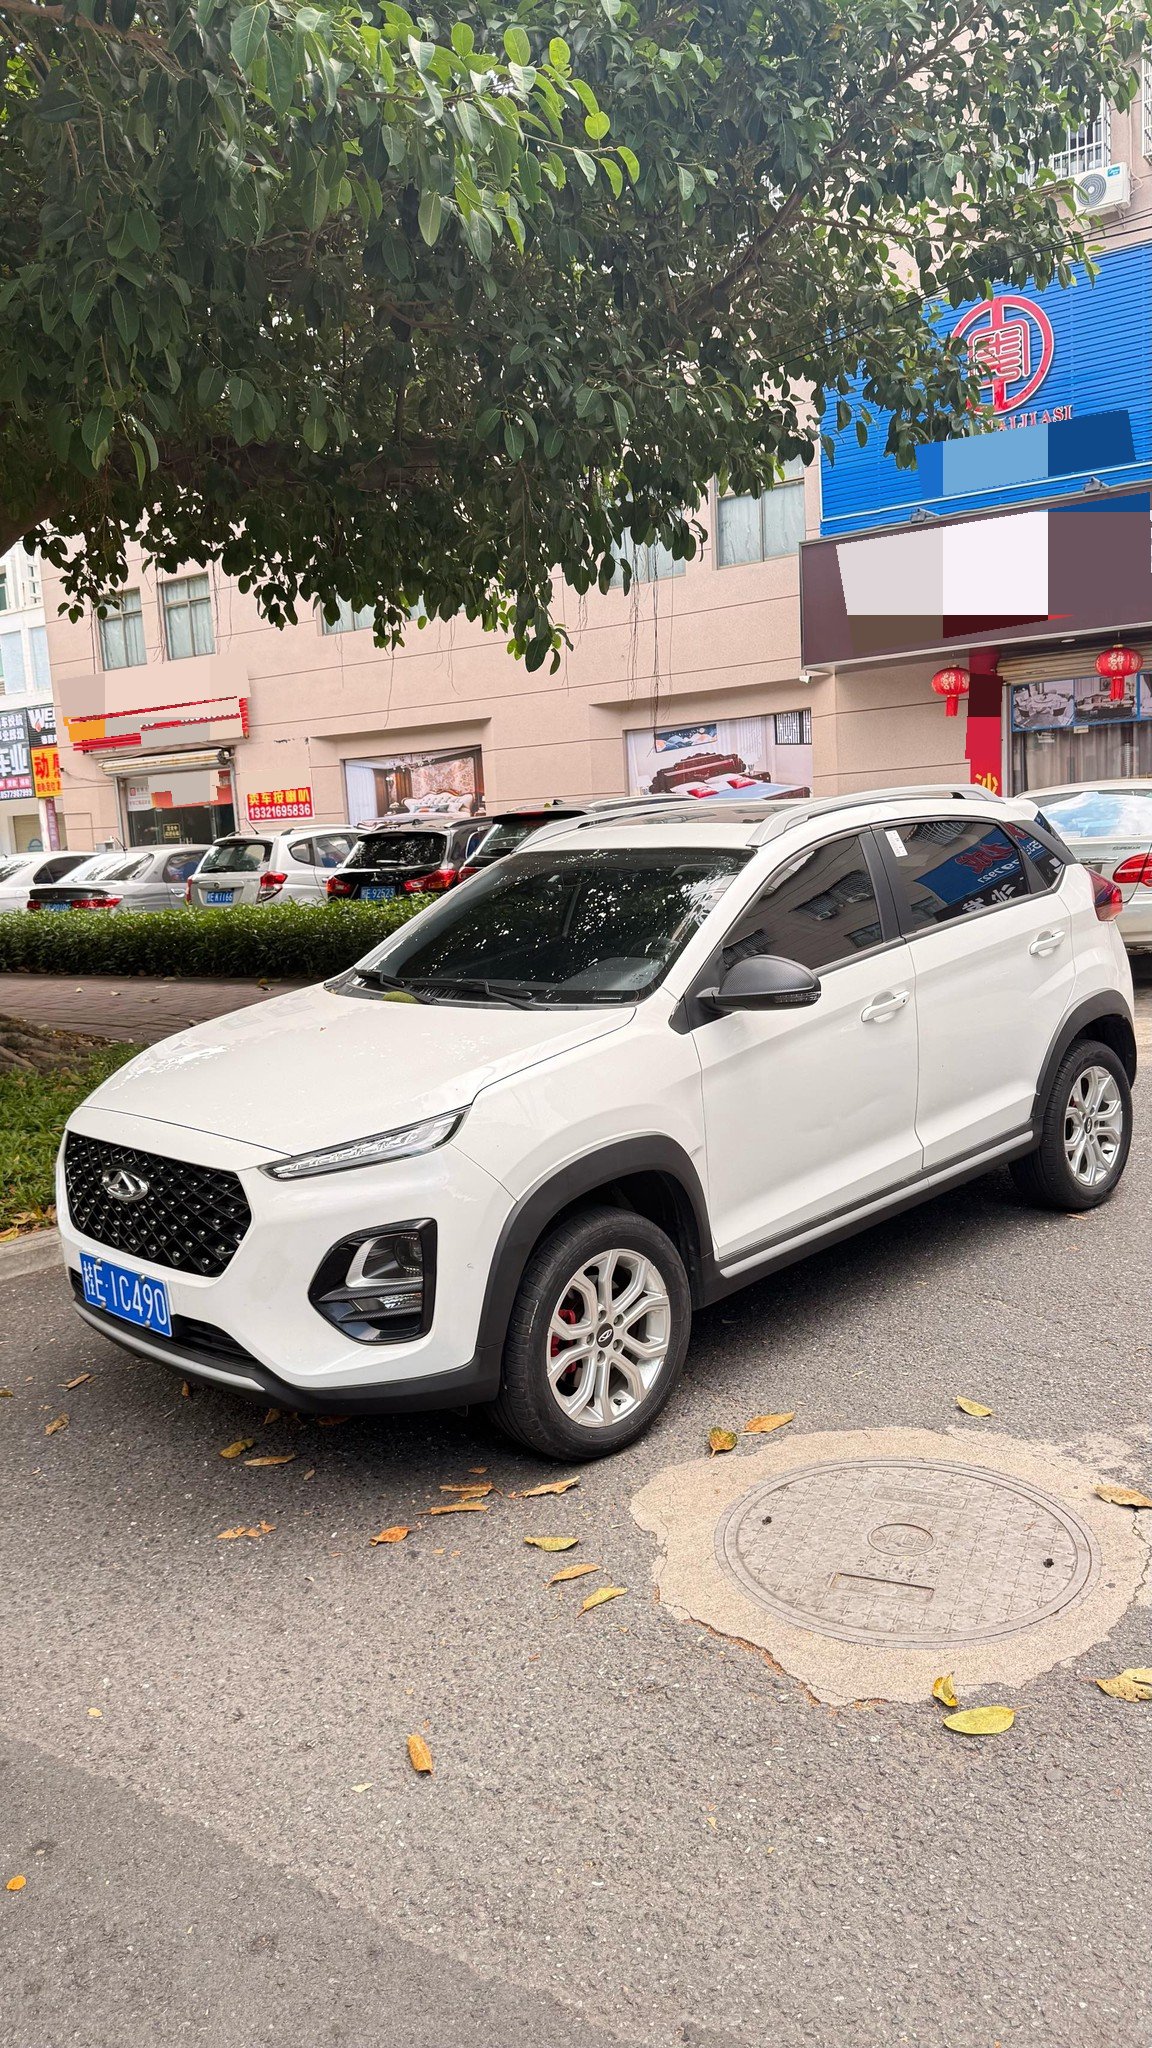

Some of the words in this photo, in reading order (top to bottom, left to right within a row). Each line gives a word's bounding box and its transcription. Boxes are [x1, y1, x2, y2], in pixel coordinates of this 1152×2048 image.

[249, 789, 310, 806] 卖车按喇叭
[250, 803, 311, 819] 13321695836
